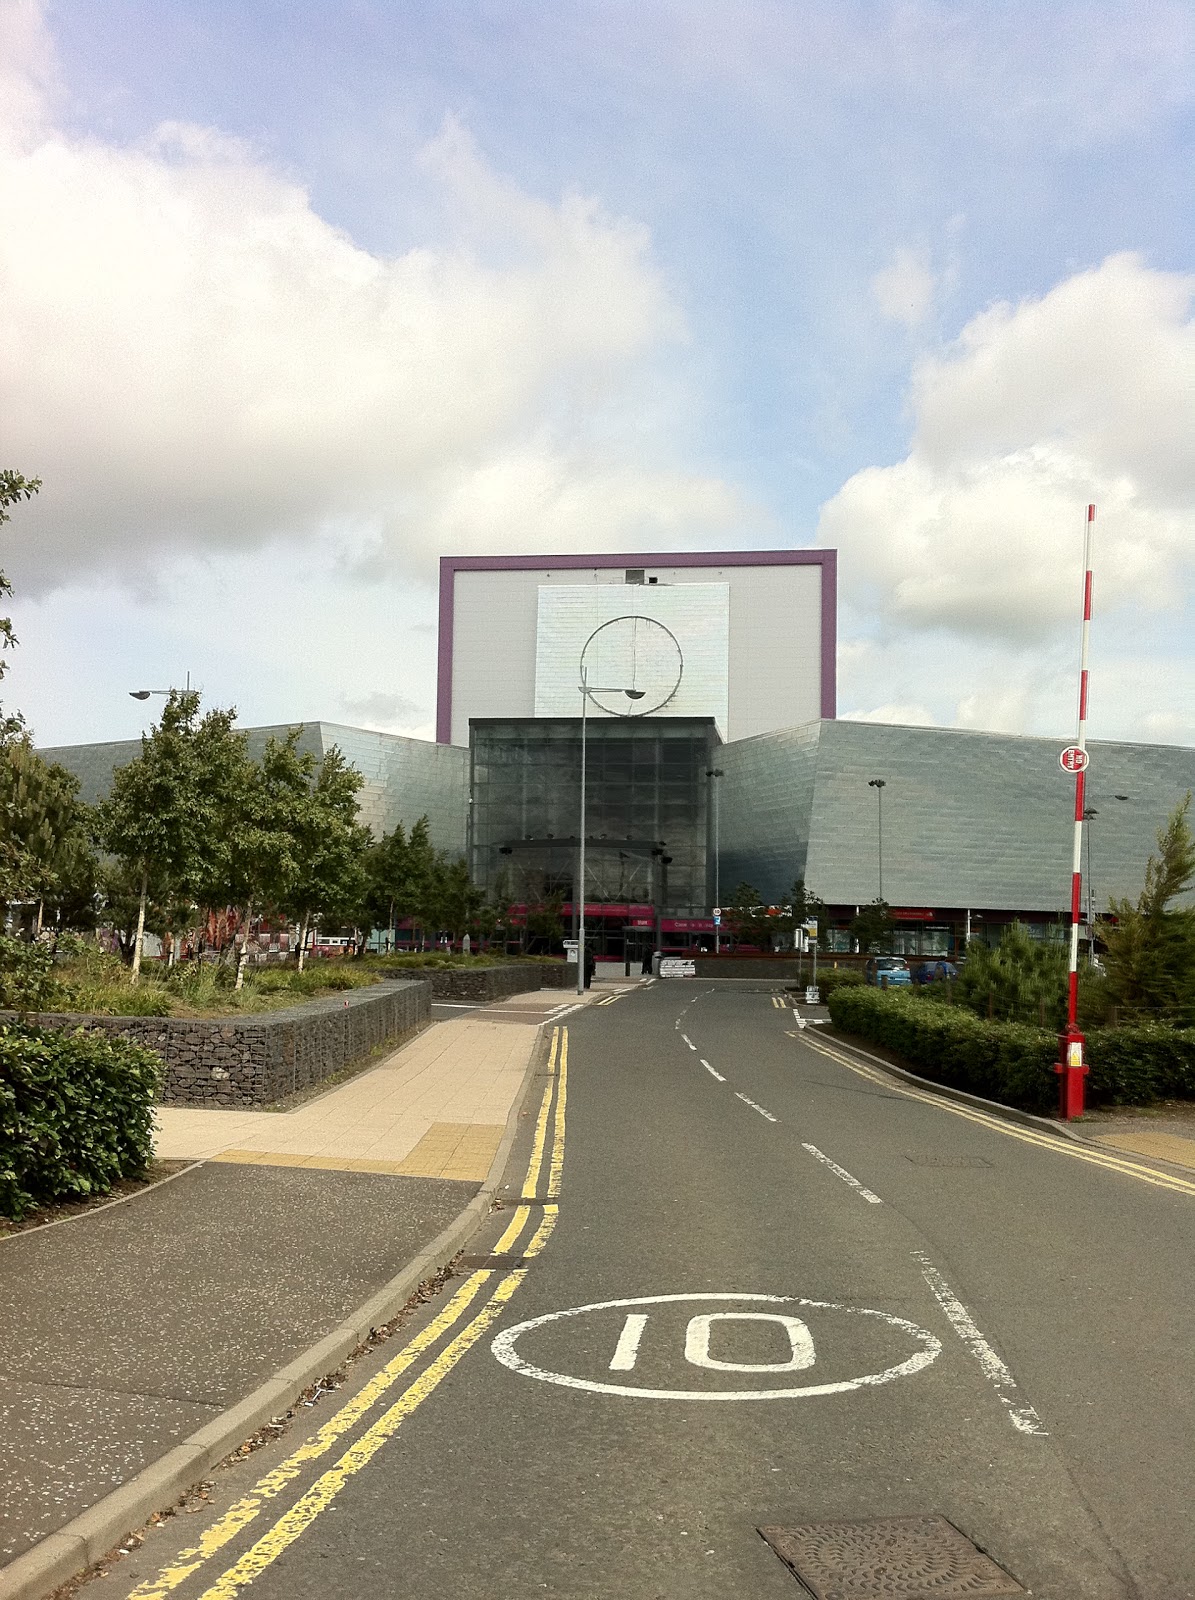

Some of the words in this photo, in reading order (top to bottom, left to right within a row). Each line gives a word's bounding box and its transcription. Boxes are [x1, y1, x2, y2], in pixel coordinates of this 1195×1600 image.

[1067, 749, 1075, 769] ENTRY
[1076, 754, 1083, 764] NO
[608, 1312, 816, 1372] 10
